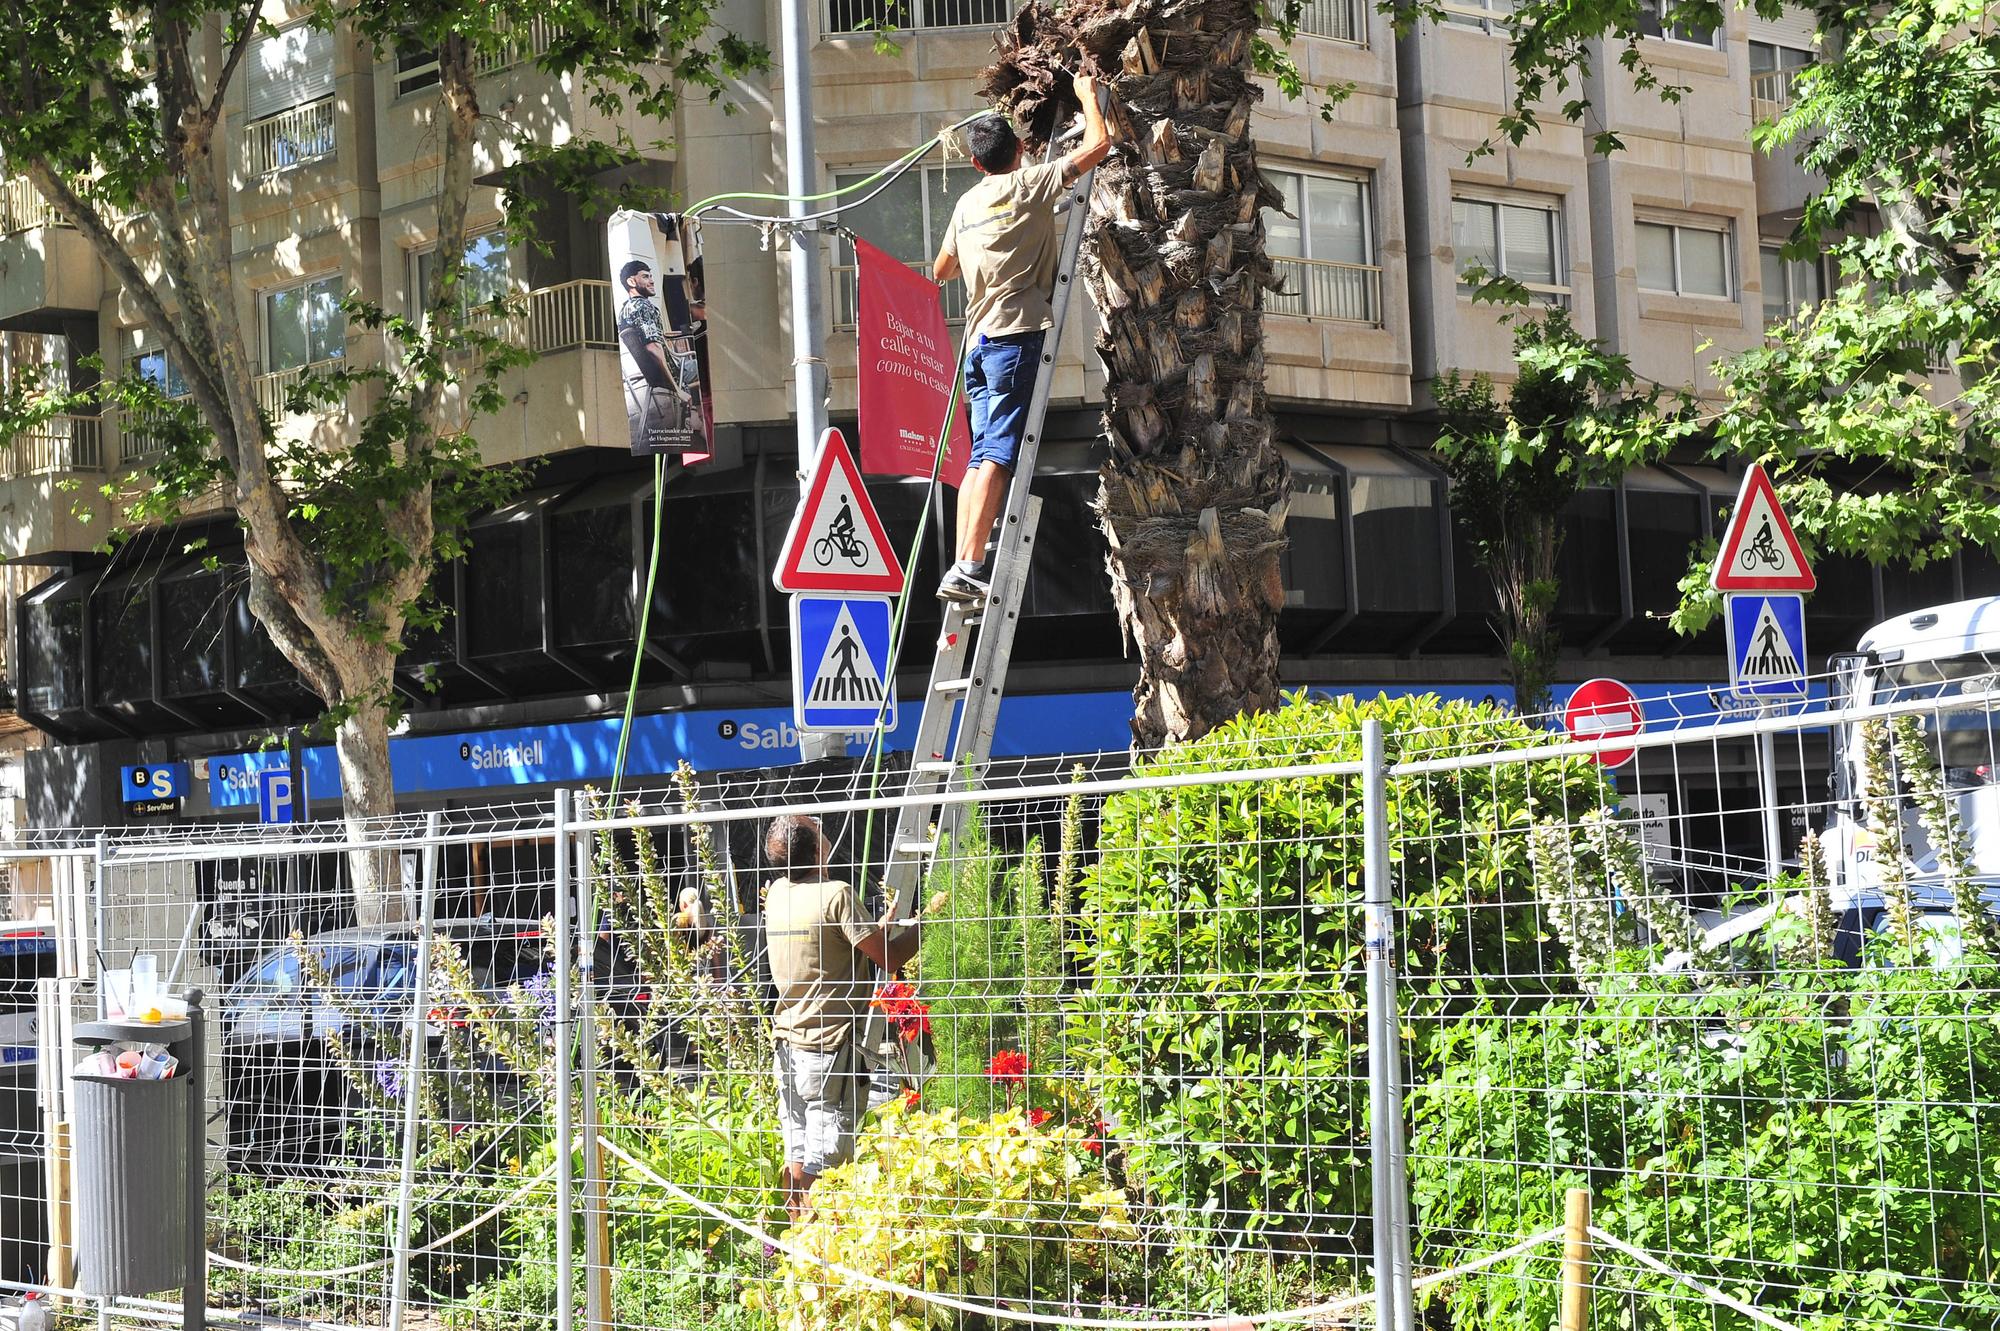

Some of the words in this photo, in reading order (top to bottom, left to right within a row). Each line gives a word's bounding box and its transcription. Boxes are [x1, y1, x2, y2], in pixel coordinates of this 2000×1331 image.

[886, 312, 914, 339] Bajar
[916, 331, 924, 344] a
[924, 335, 935, 351] tu
[881, 335, 911, 357] calle
[912, 348, 918, 364] y
[920, 352, 944, 374] estar
[877, 359, 912, 377] como
[914, 369, 928, 384] en
[929, 376, 950, 396] casa
[899, 429, 925, 441] Mahou
[1722, 695, 1790, 719] Sabaell
[471, 740, 544, 770] Sabadell
[152, 769, 172, 798] S
[269, 776, 293, 822] P
[217, 879, 246, 890] Cuena
